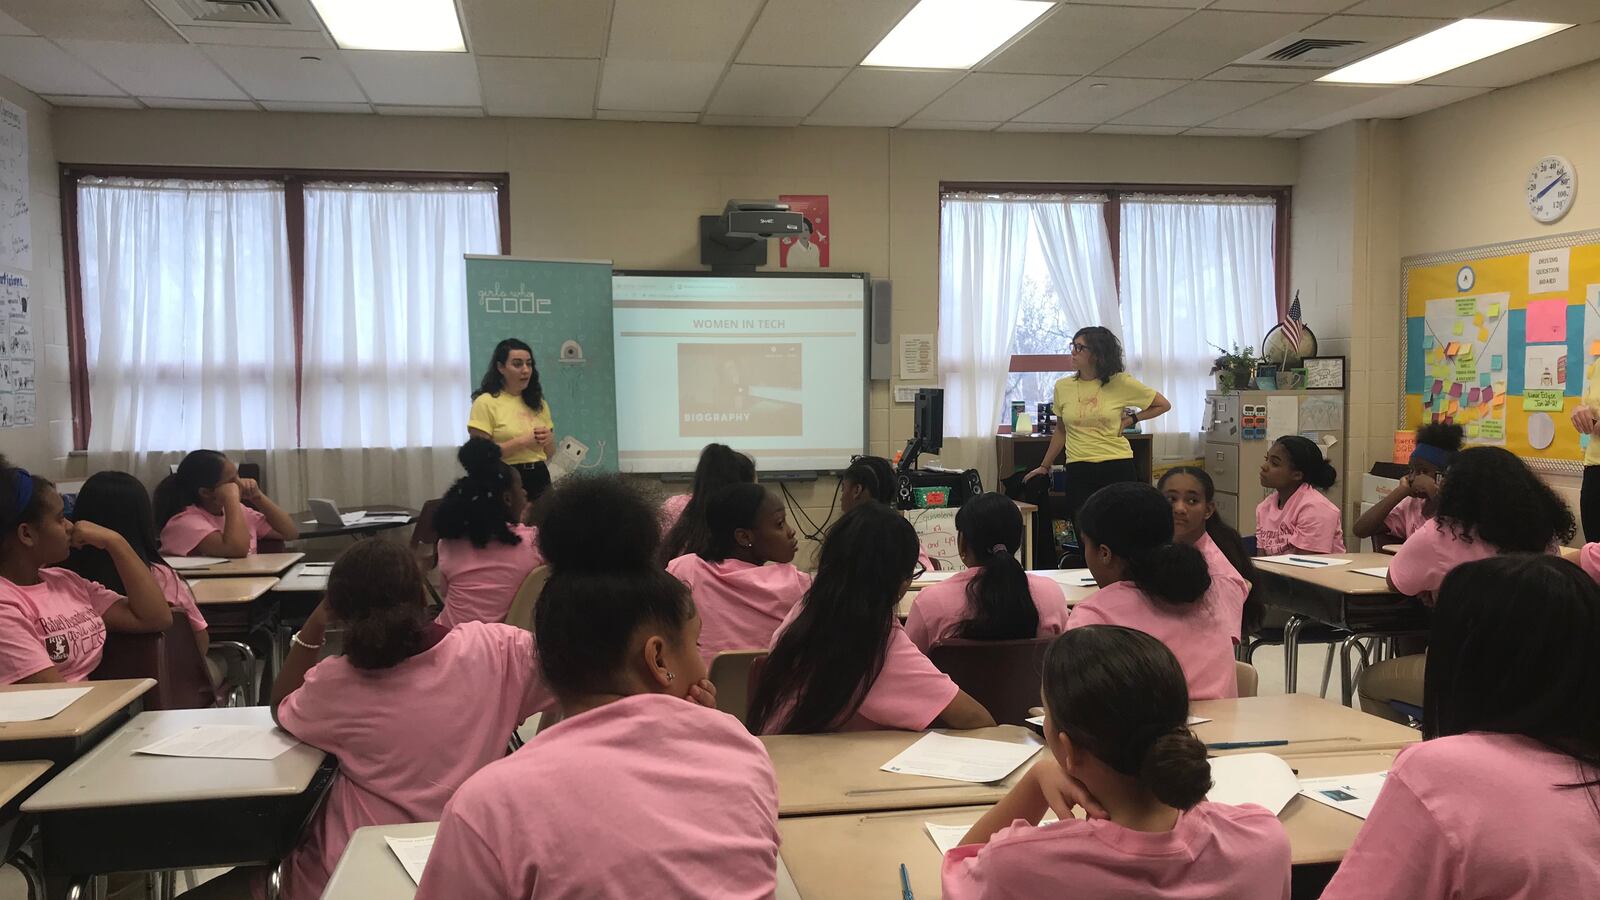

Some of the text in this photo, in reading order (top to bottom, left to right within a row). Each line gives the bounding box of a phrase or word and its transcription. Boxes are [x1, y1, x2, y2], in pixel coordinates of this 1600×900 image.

[478, 281, 507, 305] girls
[692, 319, 786, 329] WOMEN IN TECH
[684, 412, 751, 423] BIOGRAPHY
